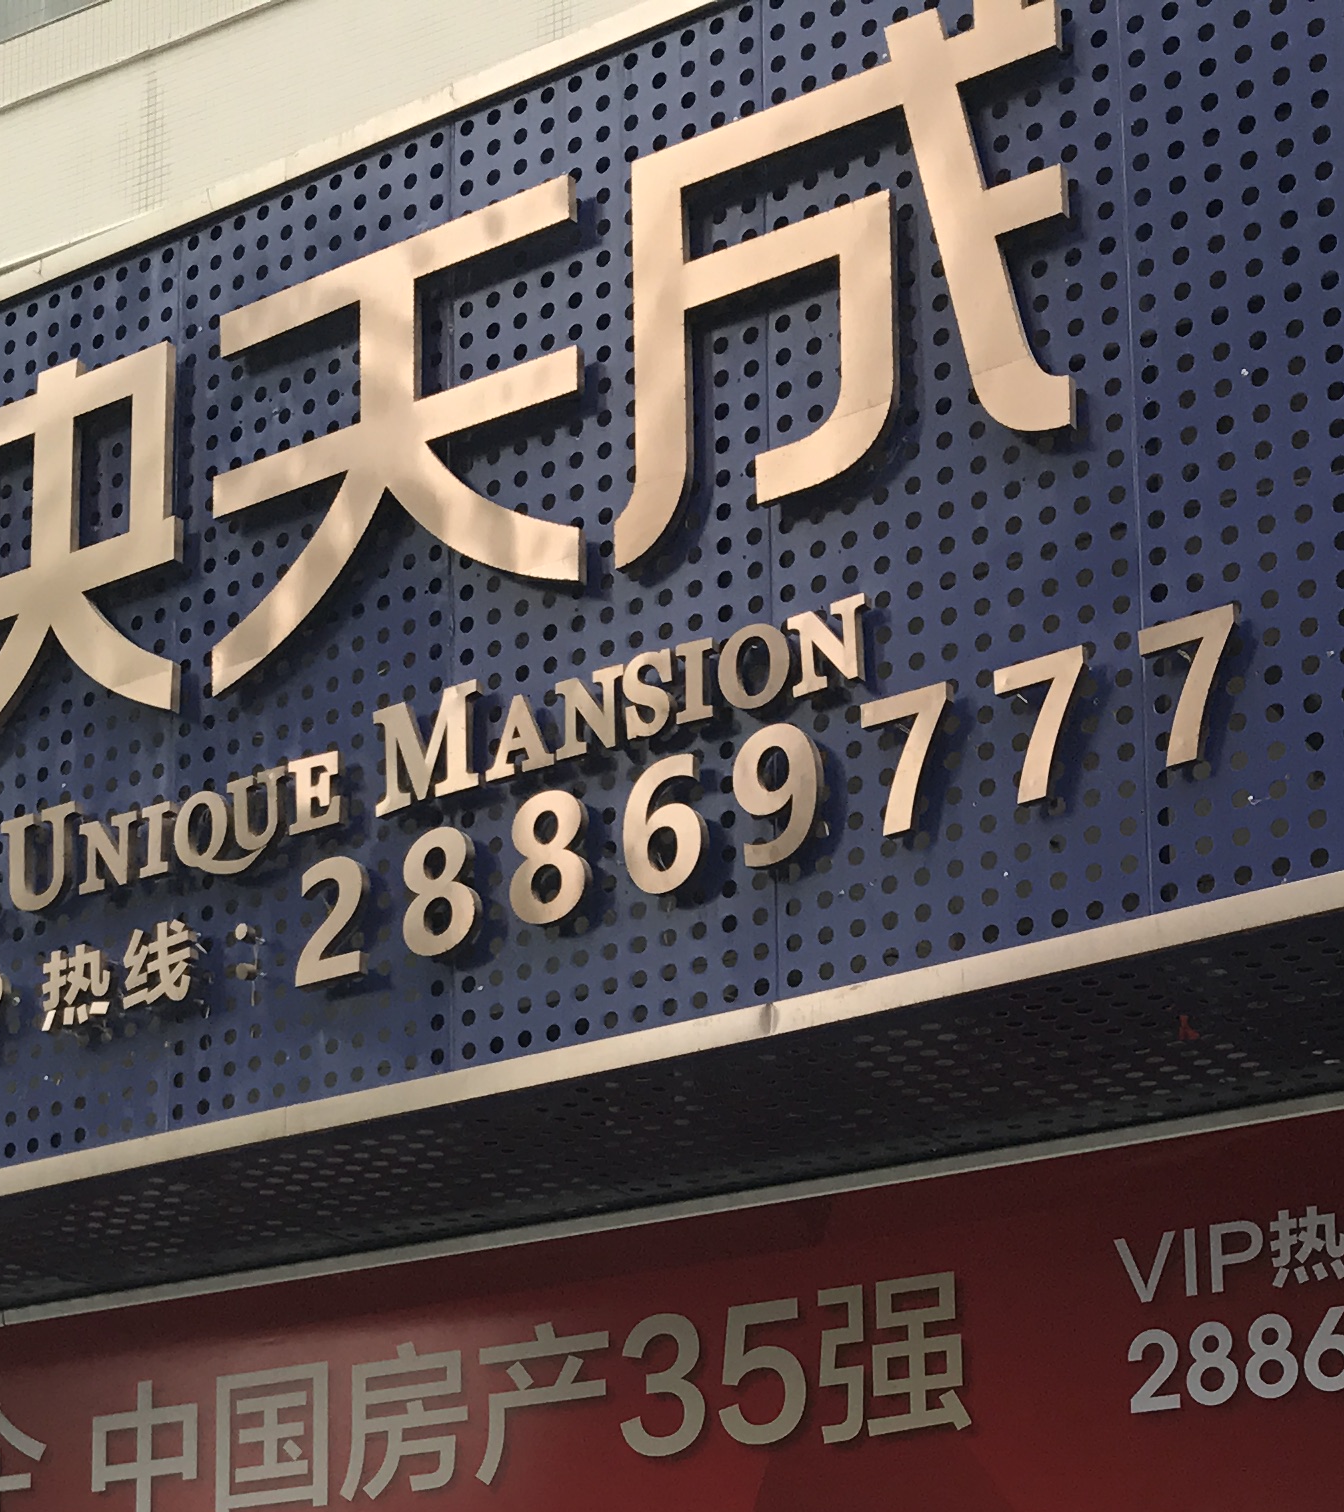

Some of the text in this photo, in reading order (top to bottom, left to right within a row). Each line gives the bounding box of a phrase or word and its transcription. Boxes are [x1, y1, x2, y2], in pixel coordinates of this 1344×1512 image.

[1, 750, 342, 911] UNIQUE
[372, 593, 869, 818] MANSION
[294, 603, 1239, 989] 28869777
